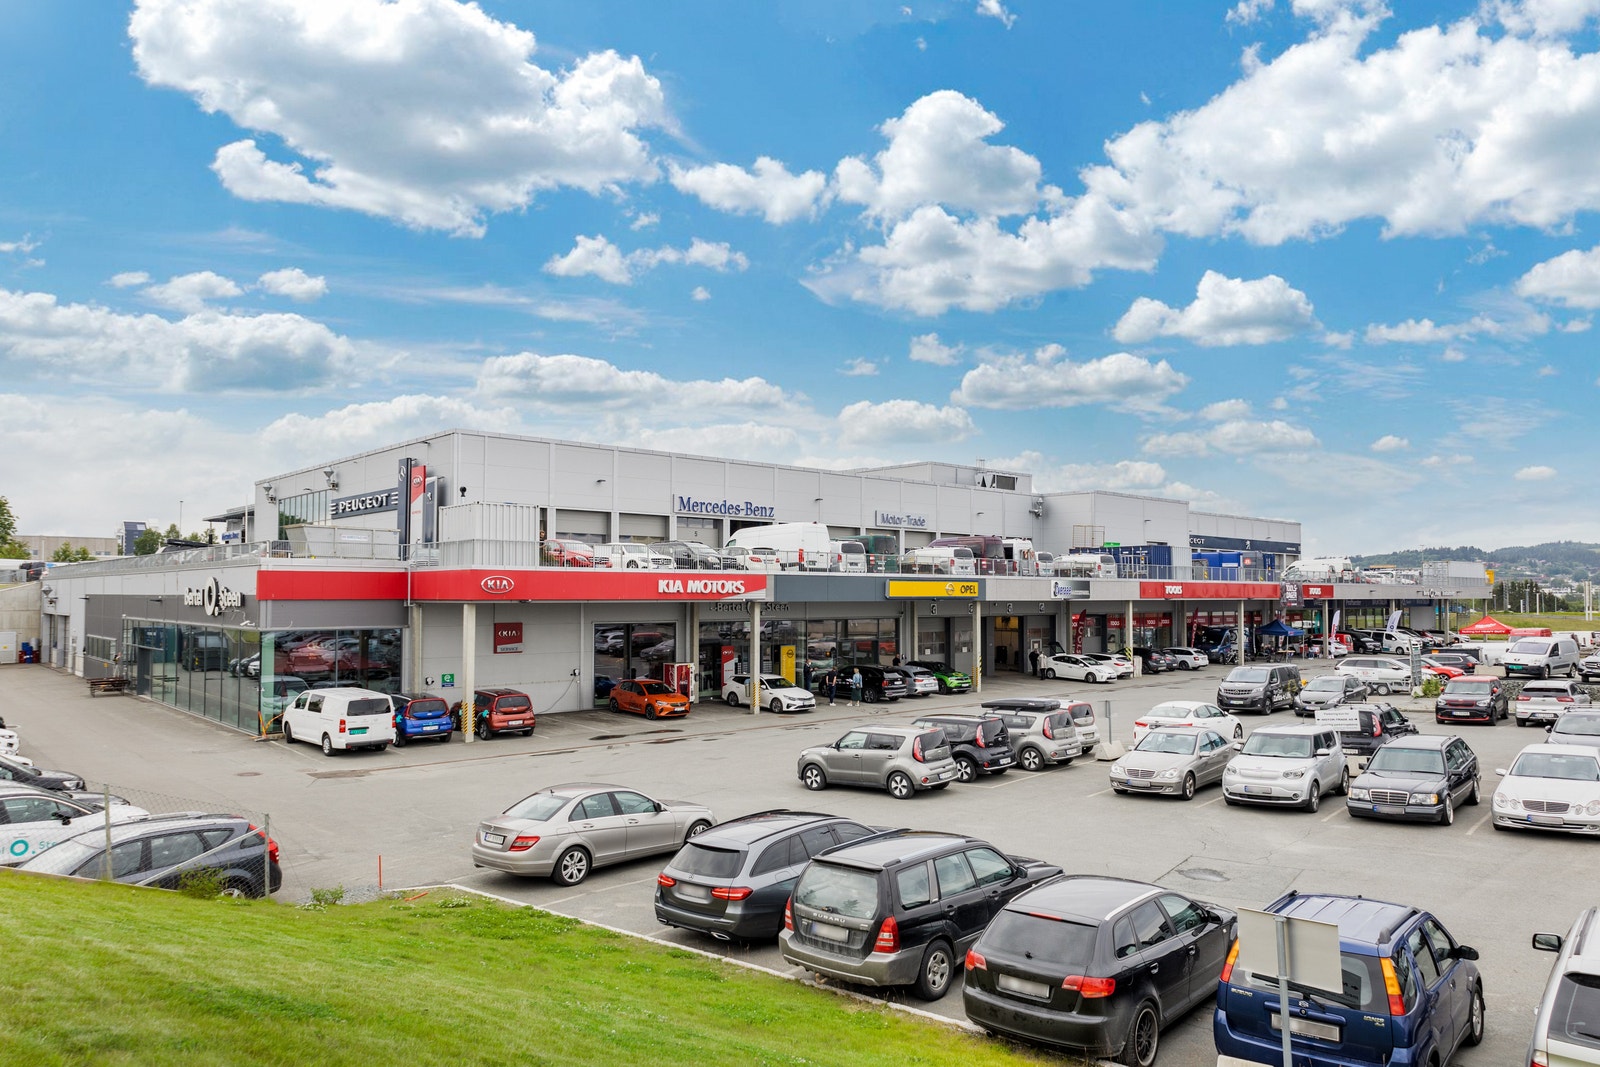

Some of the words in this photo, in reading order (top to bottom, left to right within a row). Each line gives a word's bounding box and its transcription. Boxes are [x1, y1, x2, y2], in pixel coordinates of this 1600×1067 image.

[339, 492, 389, 513] PEUGEOT
[678, 496, 775, 517] Mercedes-Benz
[881, 513, 926, 527] Motor-Trade
[487, 579, 509, 590] KIA
[658, 579, 684, 593] KIA
[687, 580, 745, 594] MOTORS
[960, 585, 977, 594] OPEL
[1164, 585, 1183, 595] TOOLS
[184, 587, 203, 606] Bertel
[766, 602, 789, 611] Steen
[813, 912, 846, 923] SUBARU
